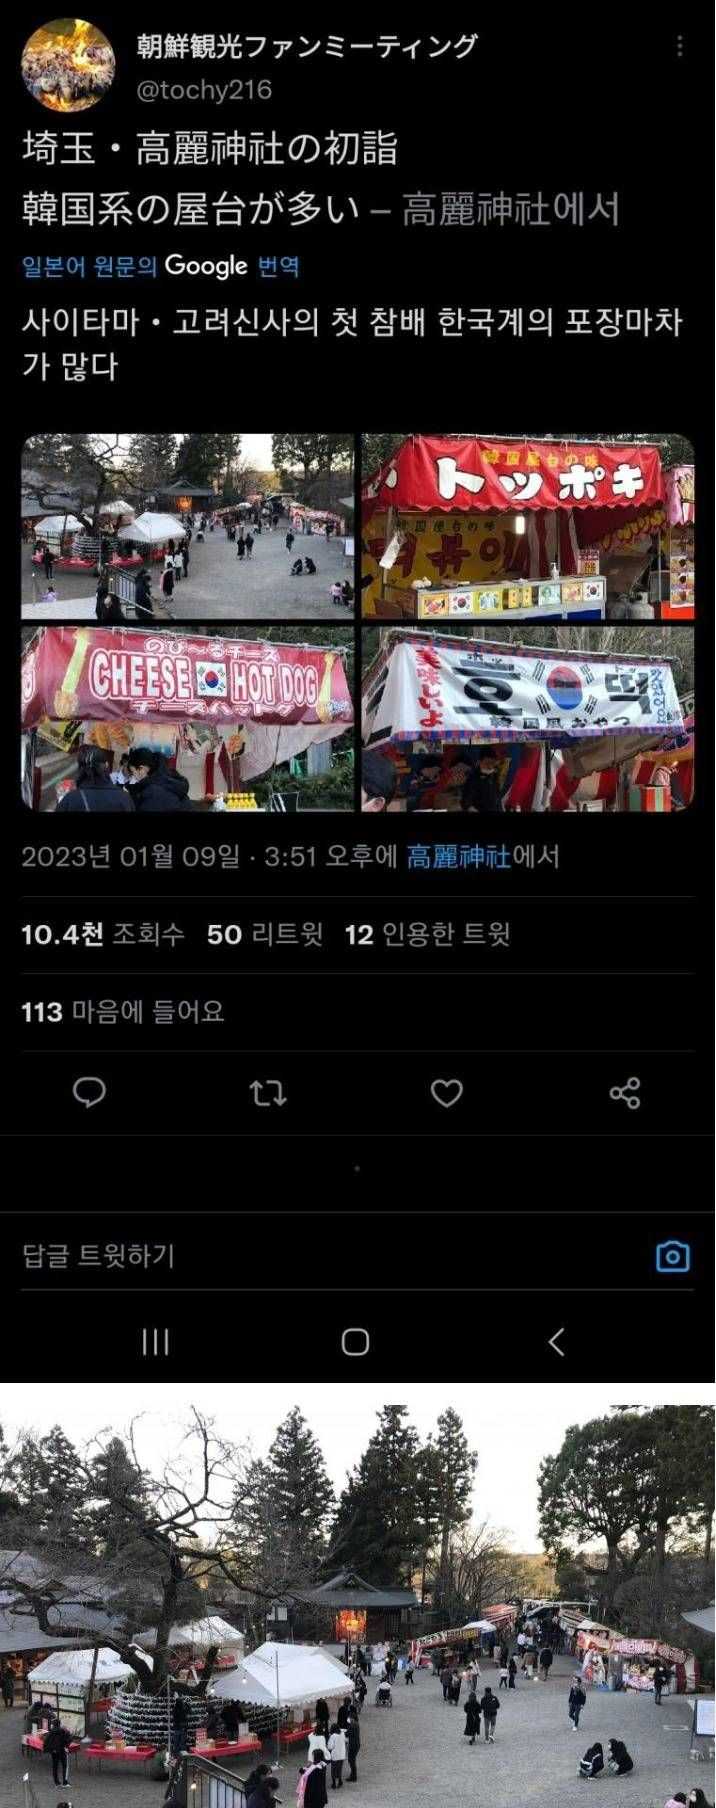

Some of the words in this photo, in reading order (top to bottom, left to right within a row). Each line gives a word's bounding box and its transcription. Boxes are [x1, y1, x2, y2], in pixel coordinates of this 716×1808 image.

[137, 33, 479, 59] 朝鮮観光ファンミーティング
[138, 79, 272, 104] @tochy216
[22, 130, 398, 166] 埼玉・高麗神社の初詣
[22, 191, 359, 227] 韓国系の屋台が多い
[403, 191, 618, 227] 高麗神社에서
[22, 256, 85, 278] 일본어
[94, 256, 157, 278] 원문의
[165, 254, 248, 280] Google
[258, 256, 300, 278] 번역
[332, 308, 358, 337] 첫
[370, 308, 425, 337] 참배
[438, 308, 553, 337] 한국계의
[565, 308, 684, 337] 포장마차
[23, 352, 51, 382] 가
[62, 352, 119, 383] 많다
[437, 457, 645, 501] トッポキ
[90, 650, 193, 700] CHEESE
[230, 660, 279, 703] HOT
[279, 663, 319, 706] DOG
[416, 647, 443, 728] 美味しいよ
[22, 845, 110, 869] 2023년
[121, 844, 172, 868] 01월
[182, 845, 239, 869] 09일
[265, 846, 315, 867] 3:51
[326, 844, 397, 869] 오후에
[407, 844, 559, 869] 高麗神社에서
[22, 922, 104, 947] 10.4천
[113, 922, 185, 947] 조회수
[207, 925, 242, 945] 50
[253, 922, 322, 947] 리트윗
[345, 925, 374, 945] 12
[384, 922, 455, 948] 인용한
[464, 922, 509, 947] 트윗
[21, 1002, 62, 1022] 113
[73, 1000, 143, 1025] 마음에
[153, 1000, 225, 1025] 들어요
[23, 1244, 70, 1269] 답글
[79, 1244, 174, 1269] 트윗하기
